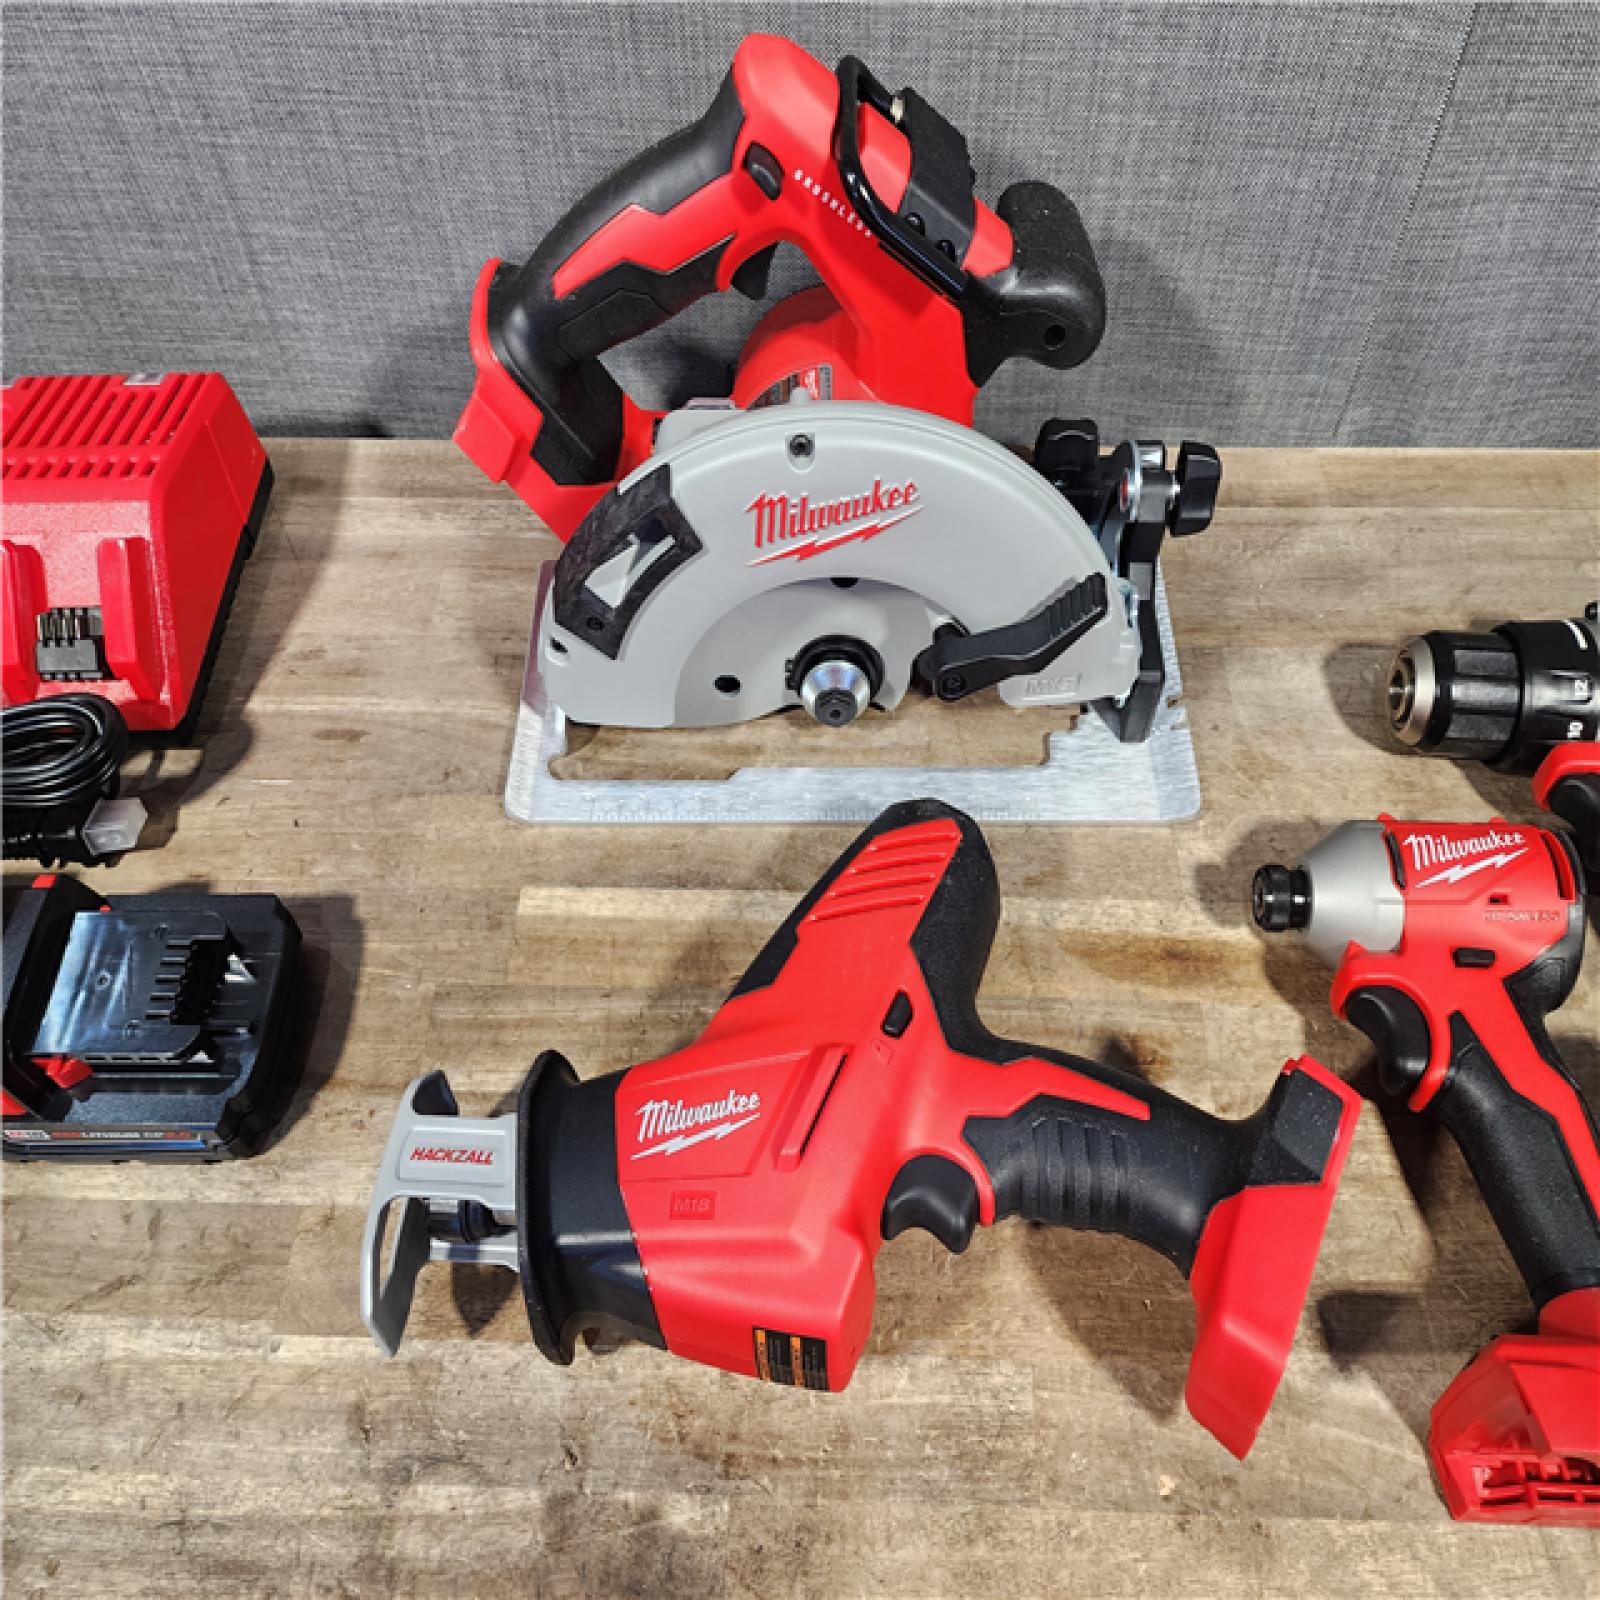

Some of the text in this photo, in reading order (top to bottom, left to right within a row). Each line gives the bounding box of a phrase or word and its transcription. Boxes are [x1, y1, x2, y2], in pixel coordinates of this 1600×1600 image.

[743, 475, 920, 549] Milwaukee
[1403, 830, 1525, 871] Milwaukee
[635, 1090, 761, 1143] Milwaukee
[409, 1146, 494, 1166] HACKZALL
